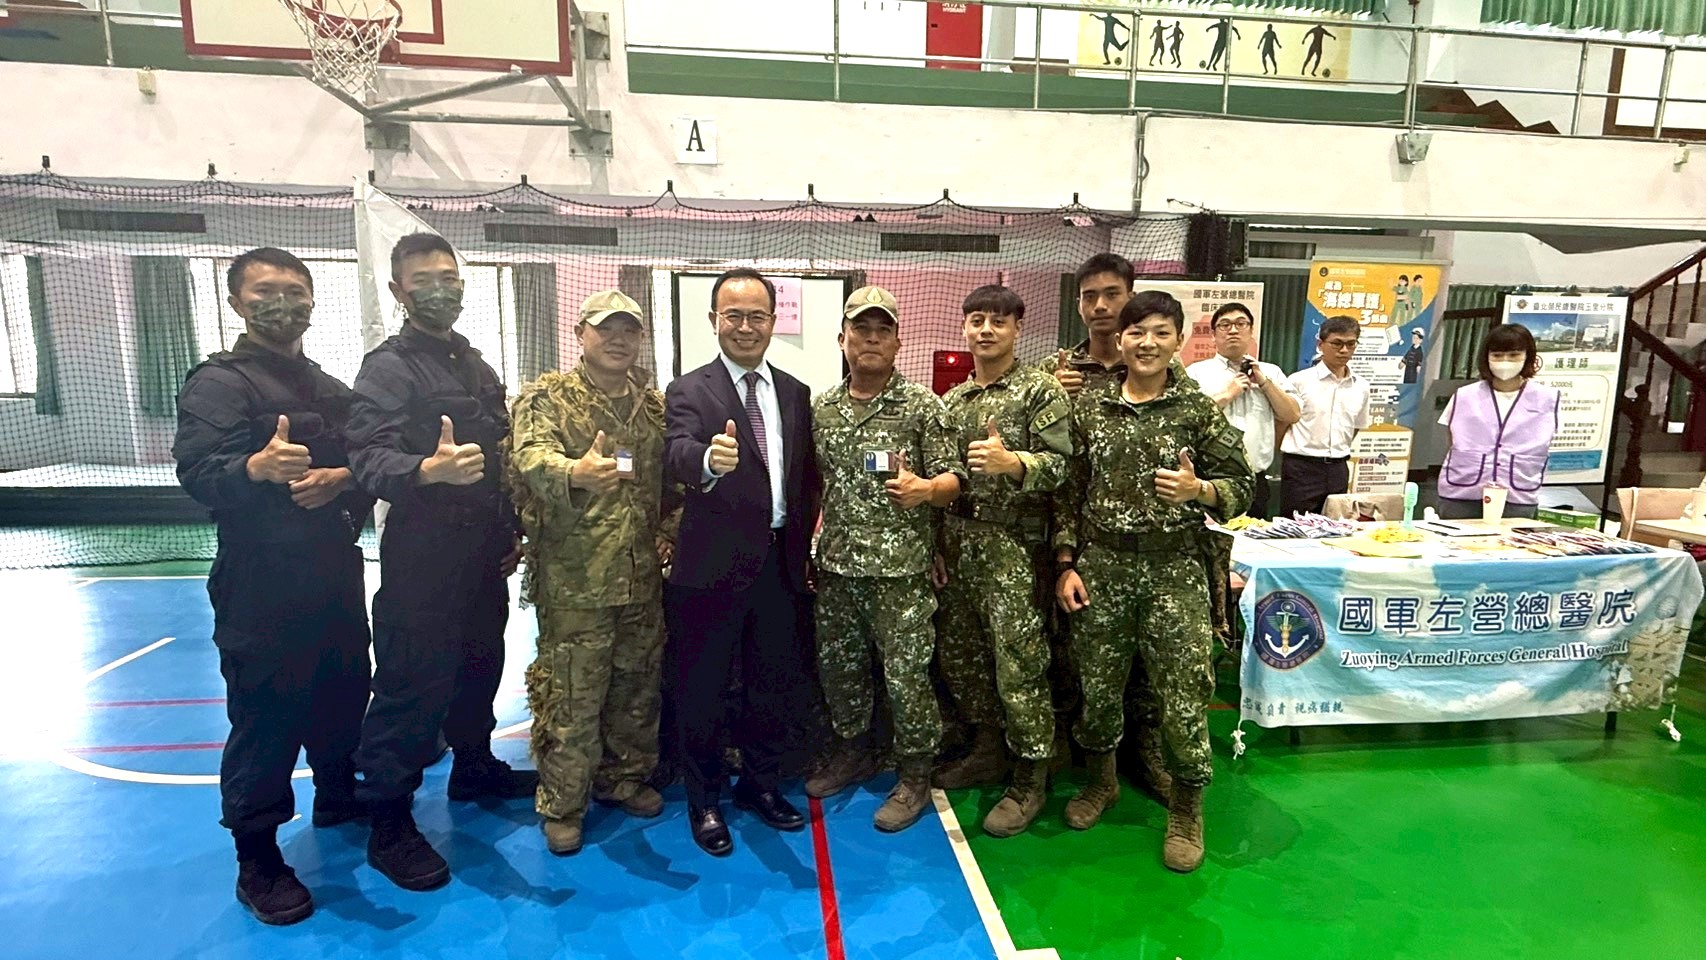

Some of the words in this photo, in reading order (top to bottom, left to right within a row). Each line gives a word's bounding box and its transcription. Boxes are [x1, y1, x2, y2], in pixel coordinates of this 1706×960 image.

[685, 119, 706, 152] A
[1193, 289, 1255, 300] 國軍左營總醫院
[1201, 302, 1222, 313] 臨床
[1554, 357, 1589, 369] 護理師
[1038, 411, 1054, 427] SF
[1339, 589, 1635, 634] 國軍左營總醫院
[1341, 650, 1397, 670] Zuoying
[1400, 650, 1453, 665] Armed
[1458, 649, 1504, 665] Forces
[1509, 644, 1567, 662] General
[1571, 639, 1628, 662] Hospital
